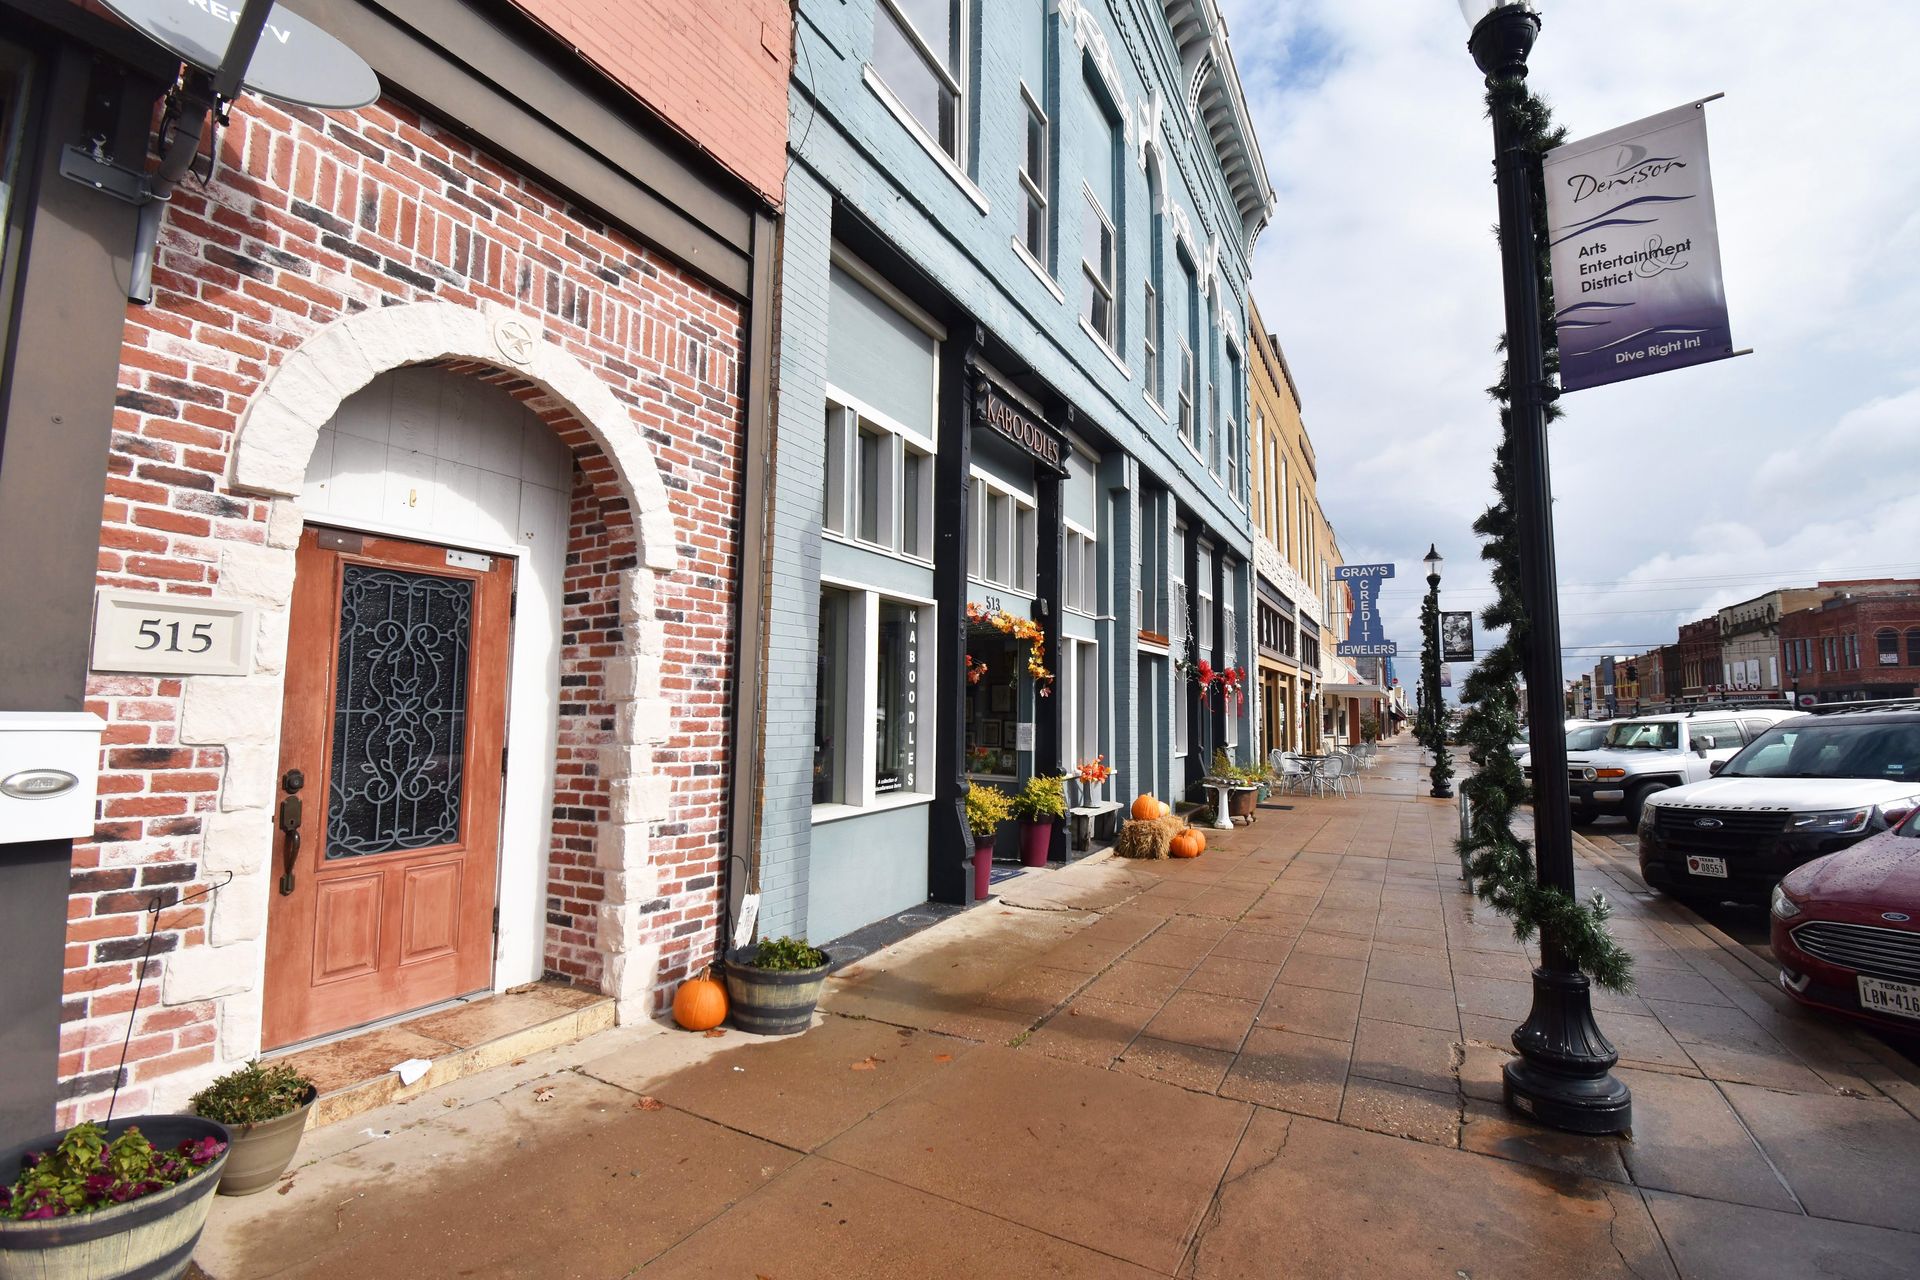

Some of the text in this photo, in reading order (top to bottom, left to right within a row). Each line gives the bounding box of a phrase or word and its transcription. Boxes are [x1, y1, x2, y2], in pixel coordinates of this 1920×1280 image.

[1567, 161, 1687, 203] Denison
[1578, 242, 1607, 259] Arts
[1580, 238, 1692, 276] Entertainment
[1581, 270, 1634, 293] District
[1615, 335, 1701, 364] Dive Right In!
[986, 393, 1060, 464] KABOODLES
[1341, 566, 1388, 578] GRAY'S
[985, 595, 1001, 611] 513
[1359, 579, 1371, 642] CREDIT
[134, 618, 213, 653] 515
[1338, 644, 1395, 655] JEWELERS
[907, 610, 917, 786] KABOODLES
[1701, 863, 1724, 874] 08553
[1879, 981, 1908, 993] TEXAS
